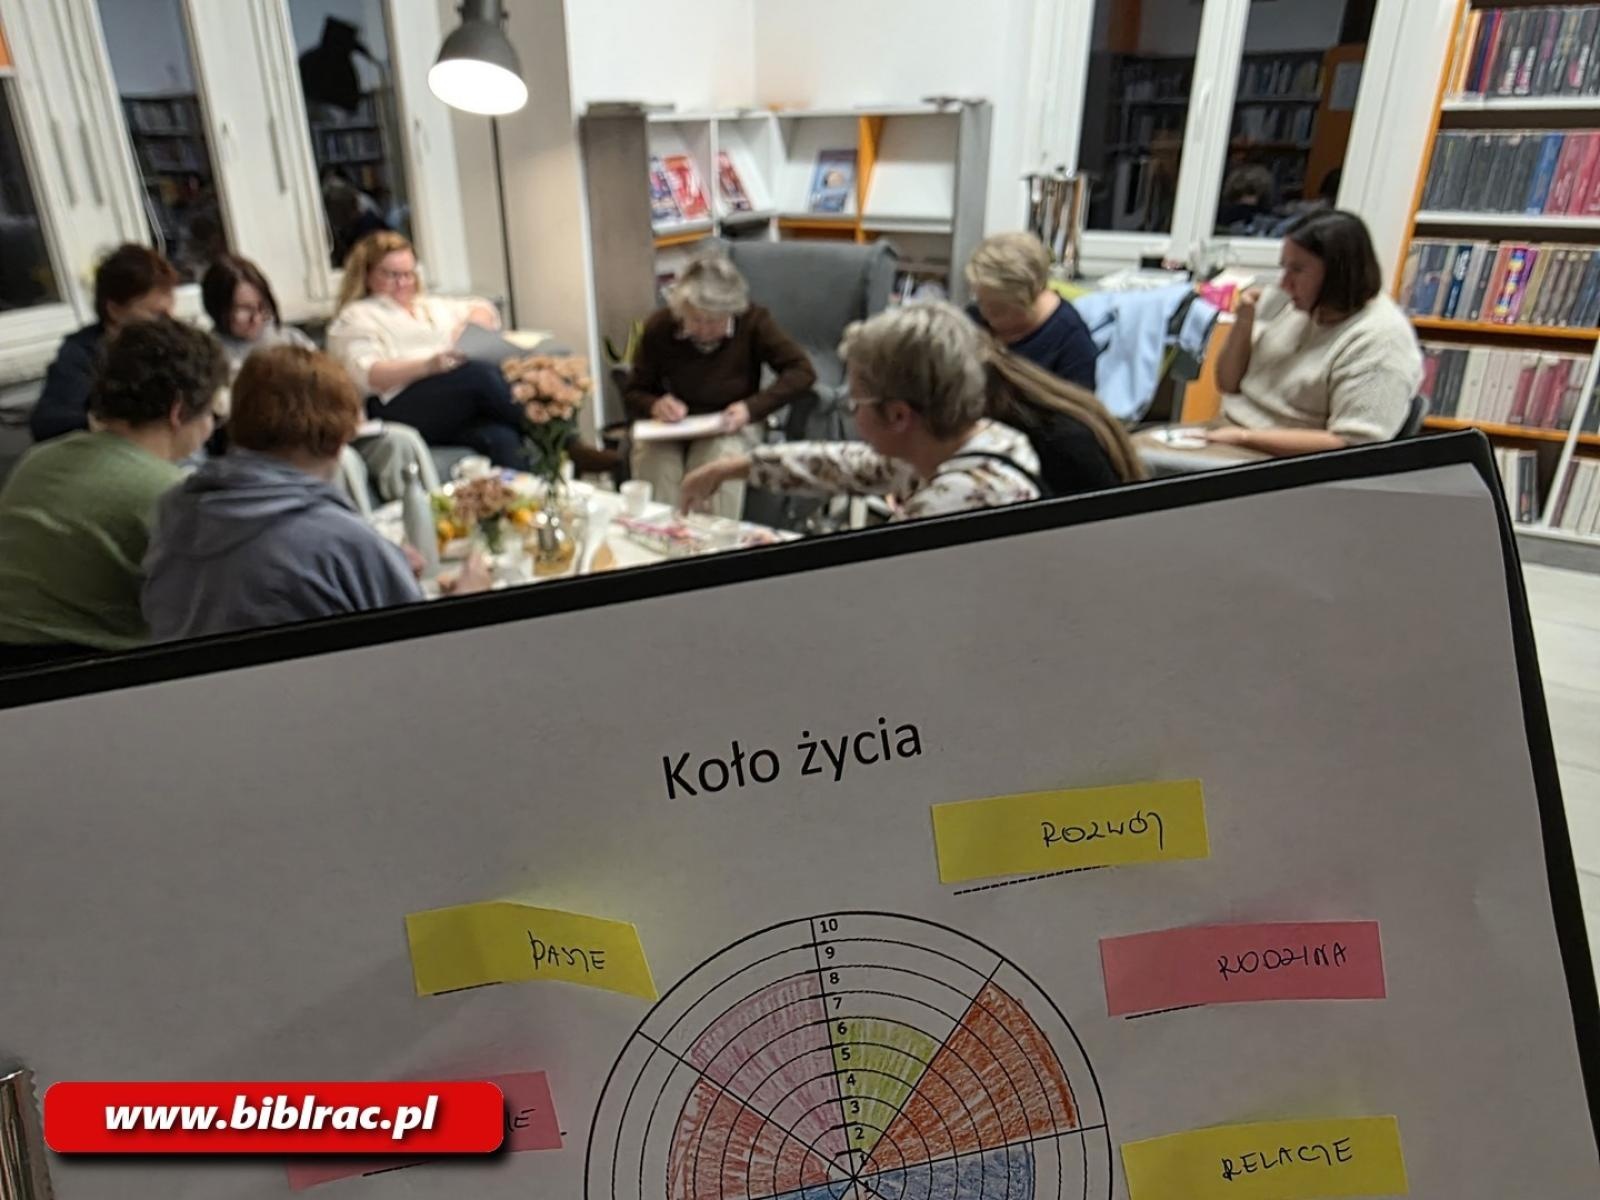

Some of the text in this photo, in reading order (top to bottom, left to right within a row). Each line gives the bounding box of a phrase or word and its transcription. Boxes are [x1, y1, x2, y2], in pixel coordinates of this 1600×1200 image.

[662, 717, 922, 800] Koło życia
[819, 918, 839, 934] 10
[527, 929, 605, 973] PASJE
[825, 945, 836, 960] 9
[1217, 942, 1347, 981] RODZINA
[829, 971, 840, 985] 8
[832, 996, 843, 1010] 7
[837, 1021, 848, 1036] 6
[841, 1046, 851, 1061] 5
[846, 1072, 857, 1087] 4
[850, 1099, 860, 1114] 3
[854, 1126, 865, 1141] 2
[1221, 1137, 1353, 1181] RELACJE
